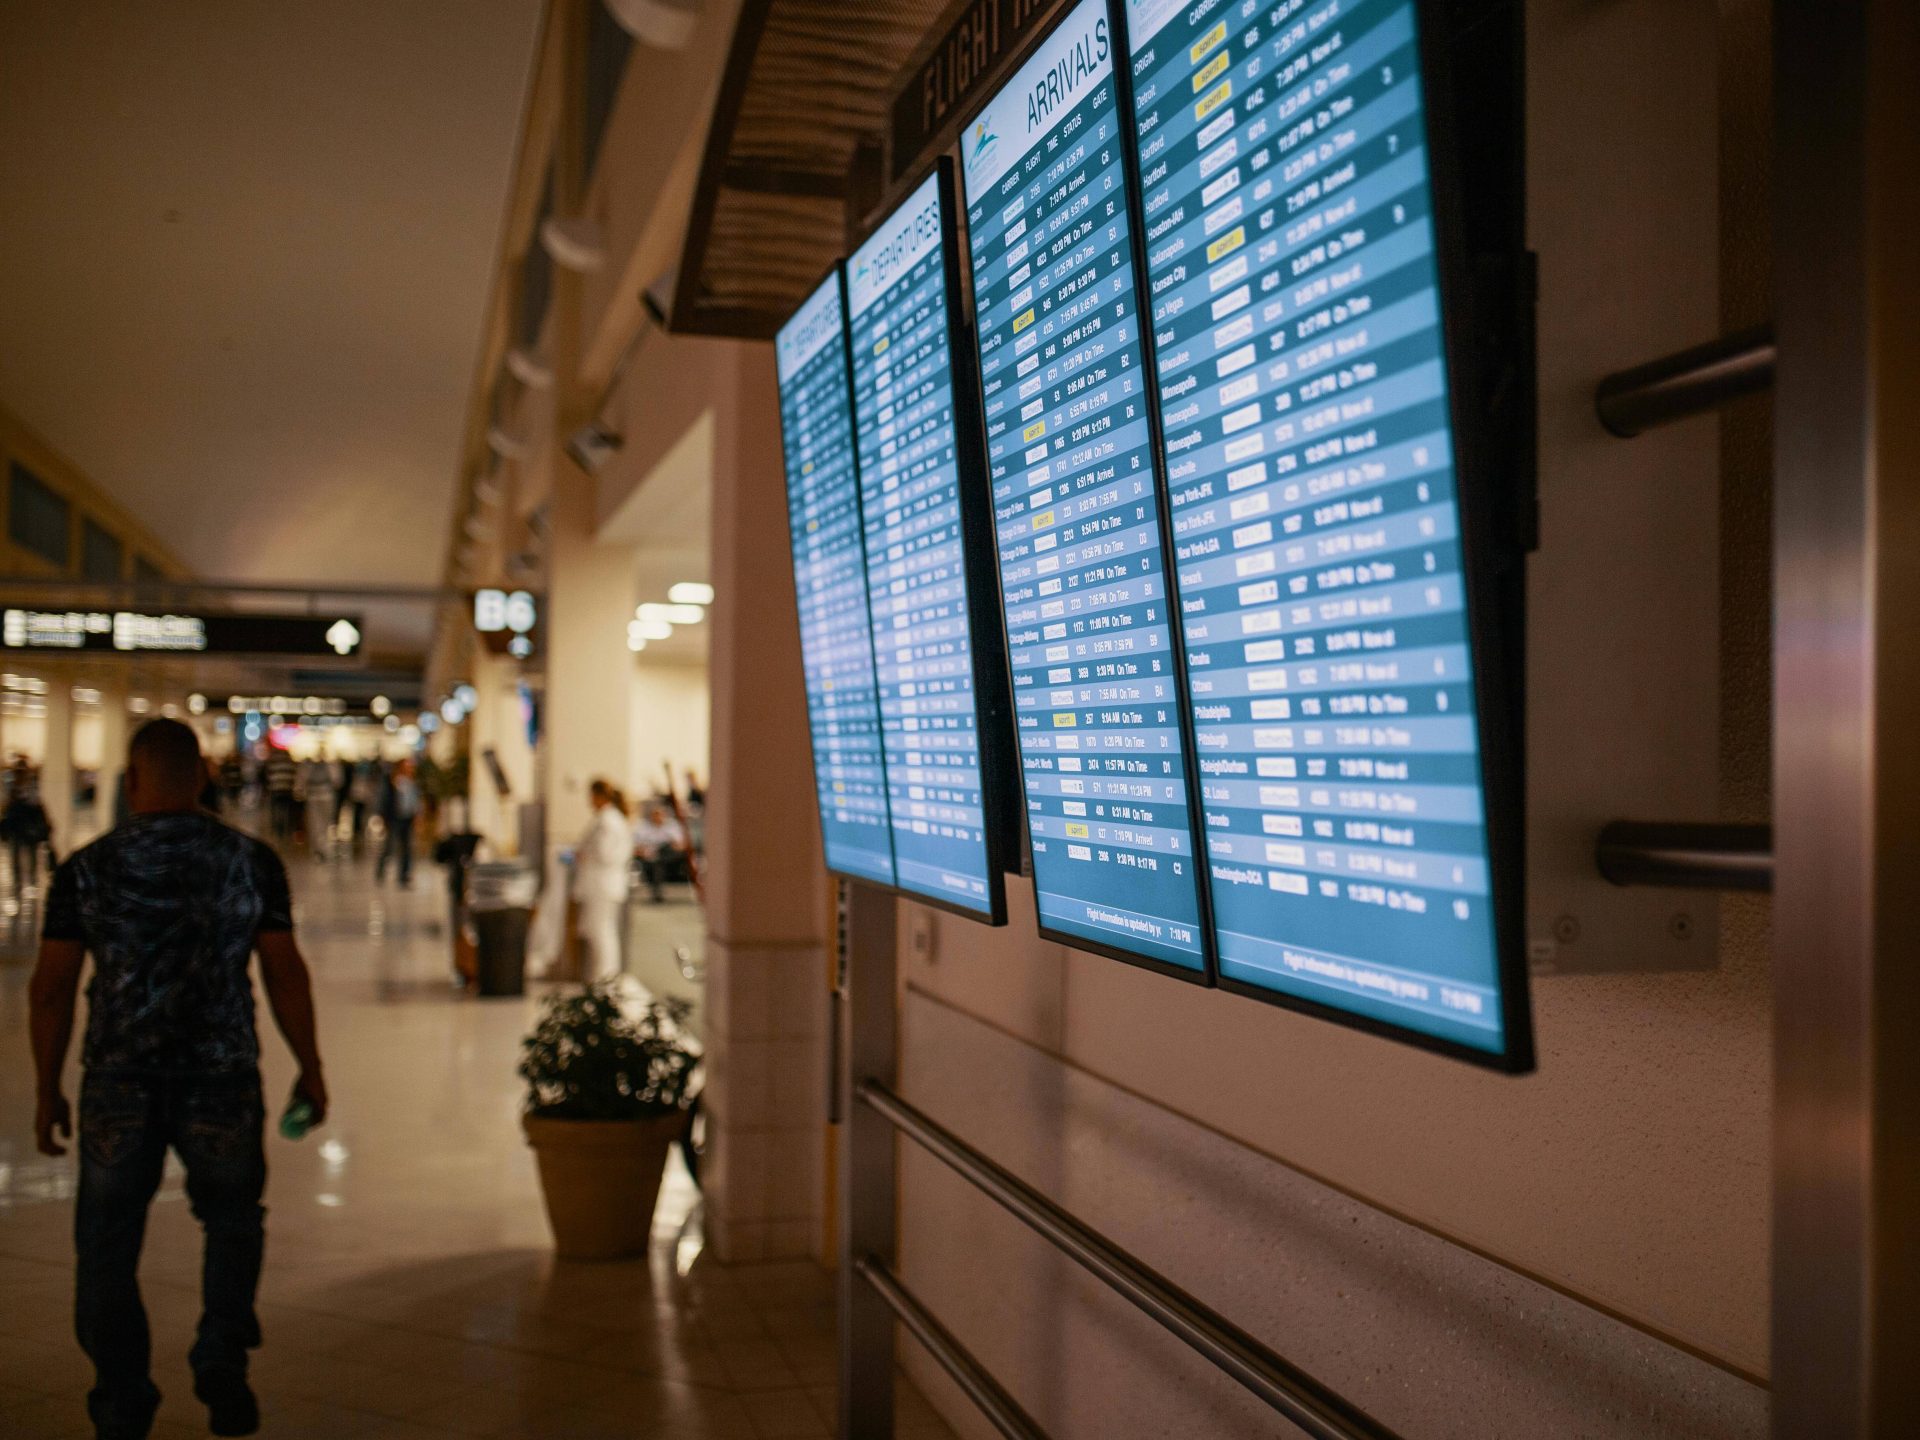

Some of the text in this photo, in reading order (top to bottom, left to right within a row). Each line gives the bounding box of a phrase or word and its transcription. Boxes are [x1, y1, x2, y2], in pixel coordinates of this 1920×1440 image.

[1134, 49, 1154, 76] ORIGIN
[1028, 17, 1109, 134] ARRIVALS
[1137, 83, 1155, 109] Detroit
[1139, 110, 1157, 135] Detroit
[1002, 171, 1019, 194] CARRIER
[1025, 150, 1040, 172] FLIGHT
[1047, 134, 1057, 151] TIME
[1063, 113, 1081, 137] STATUS
[1092, 87, 1106, 109] GATE
[1141, 134, 1164, 160] Hartford
[1068, 170, 1085, 193] Arrived
[1143, 161, 1166, 187] Hartford
[1146, 188, 1168, 213] Hartford
[1072, 228, 1080, 240] On
[1080, 219, 1092, 235] Time
[1148, 207, 1183, 240] Houston-IAH
[1075, 252, 1082, 264] On
[1082, 243, 1094, 258] Time
[1151, 237, 1184, 266] Indianapolis
[1152, 273, 1173, 293] Kansas
[1173, 264, 1185, 282] City
[1155, 295, 1184, 320] Las Vegas
[1157, 329, 1174, 347] Miami
[1087, 373, 1094, 385] On
[1094, 367, 1106, 381] Time
[1096, 466, 1113, 482] Arrived
[1101, 518, 1109, 530] On
[1109, 515, 1121, 527] Time
[1106, 567, 1114, 578] On
[1114, 564, 1126, 576] Time
[1111, 615, 1119, 627] On
[1119, 613, 1131, 625] Time
